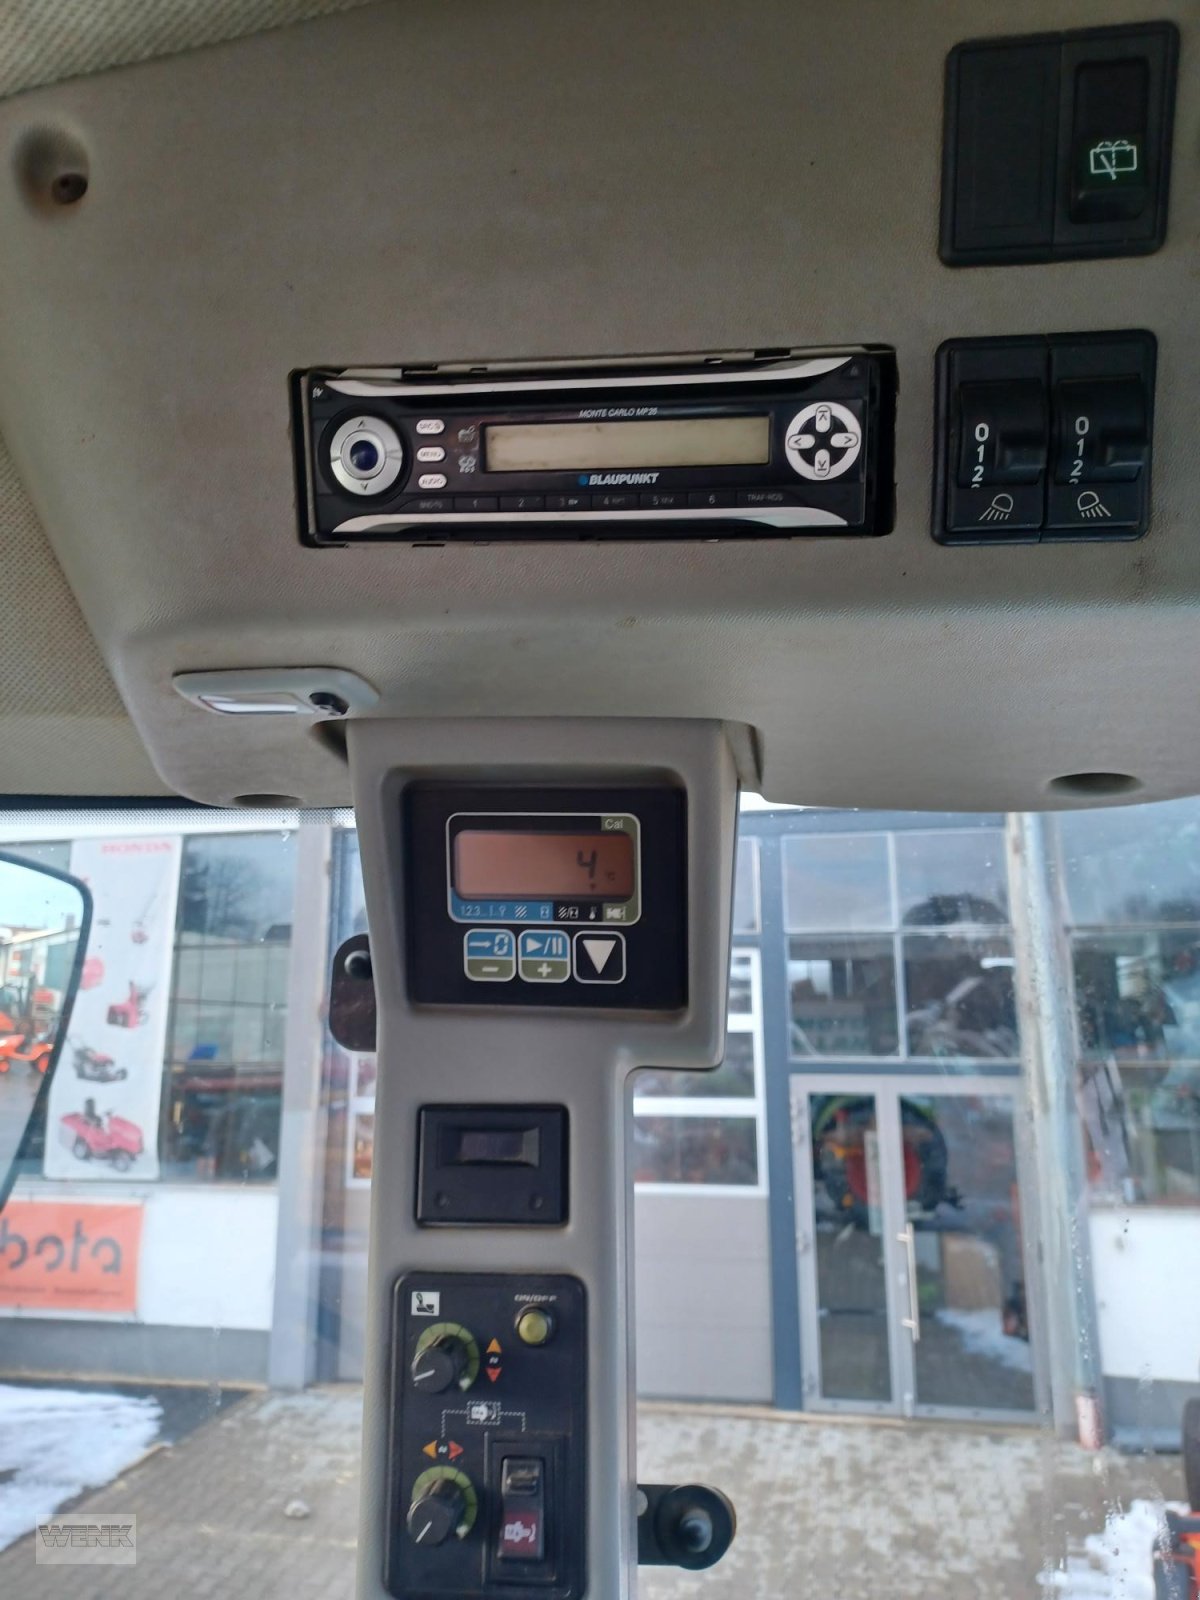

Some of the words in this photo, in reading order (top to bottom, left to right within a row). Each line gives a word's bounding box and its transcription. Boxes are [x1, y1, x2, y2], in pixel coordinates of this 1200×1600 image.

[579, 408, 607, 419] MONTE
[608, 407, 635, 418] CARLO
[974, 423, 990, 442] 0
[1075, 416, 1090, 435] 0
[976, 444, 985, 463] 1
[1076, 438, 1085, 457] 1
[971, 466, 985, 482] 2
[1070, 460, 1084, 477] 2
[589, 472, 660, 486] BLAUPUNKT
[518, 498, 526, 508] 2
[604, 818, 624, 830] Cal
[577, 851, 597, 878] 4
